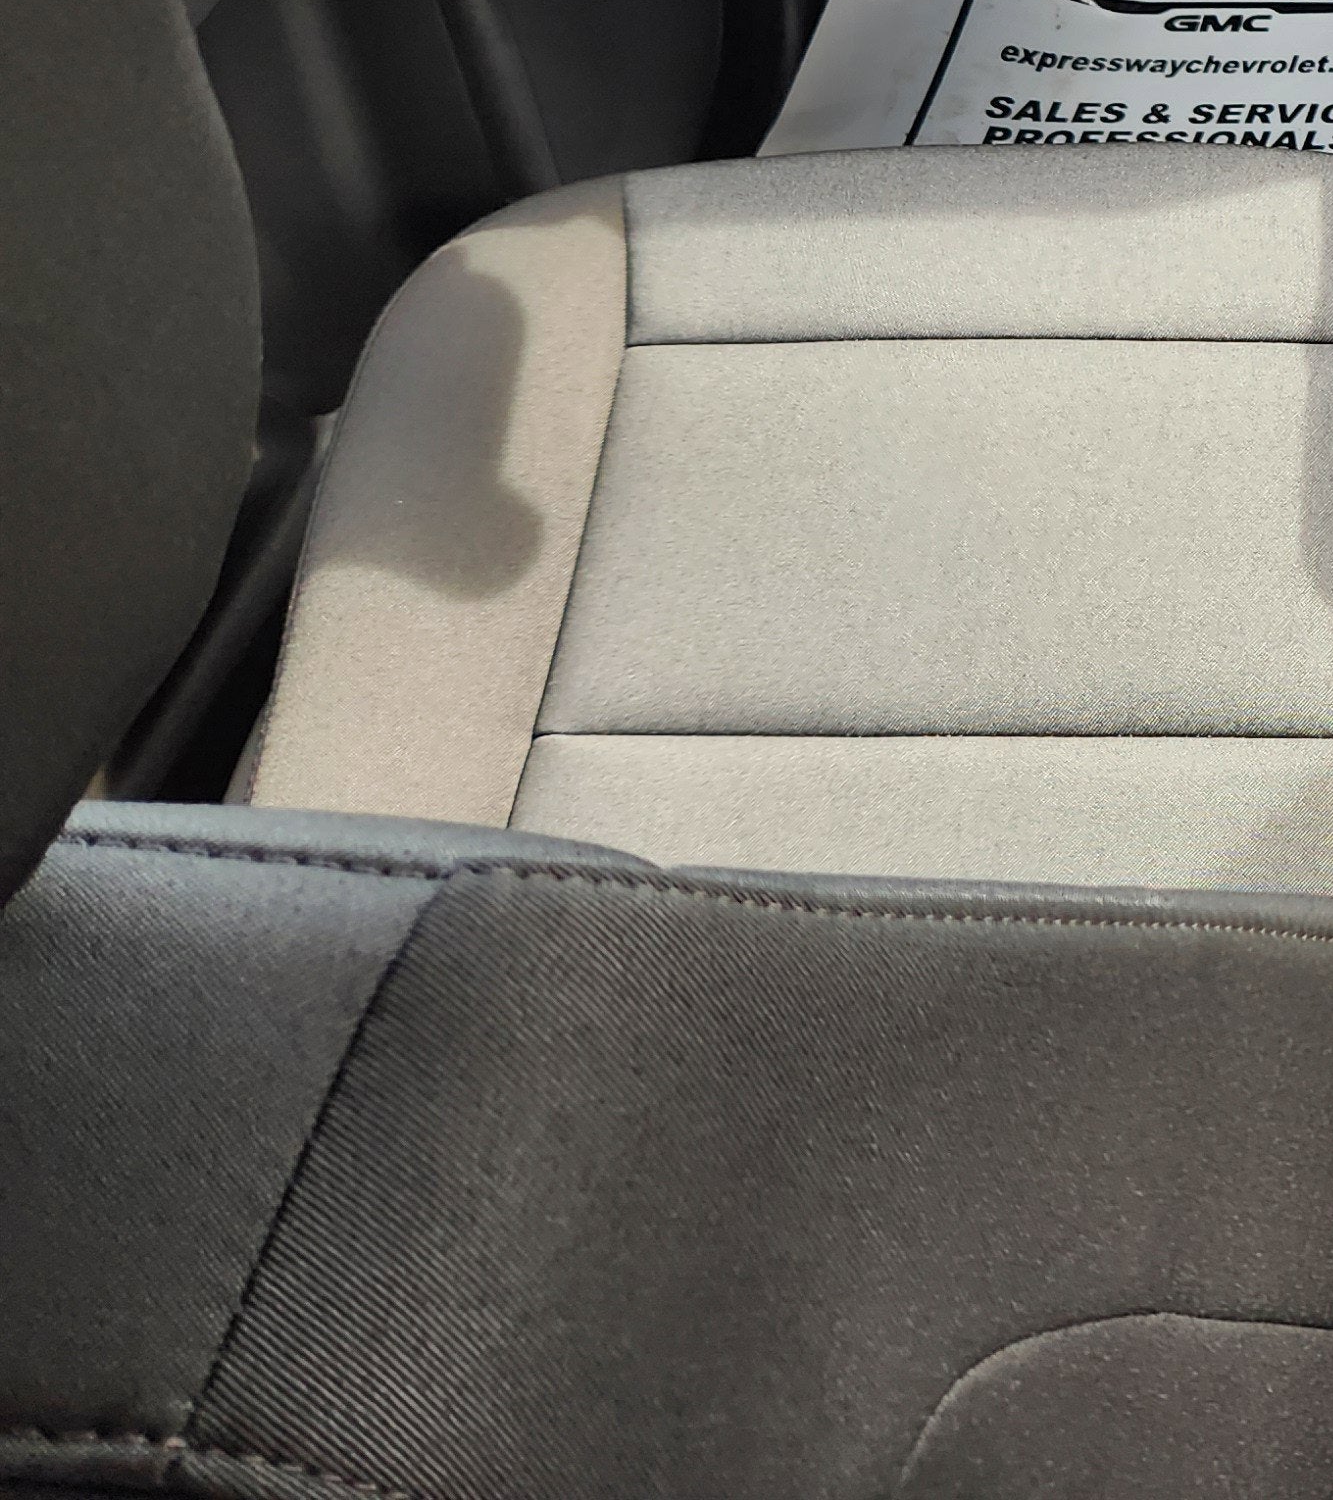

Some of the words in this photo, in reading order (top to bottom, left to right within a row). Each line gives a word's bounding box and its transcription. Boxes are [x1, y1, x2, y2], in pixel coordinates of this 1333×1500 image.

[1163, 14, 1272, 33] GMC
[985, 96, 1128, 125] SALES
[1141, 103, 1171, 125] &
